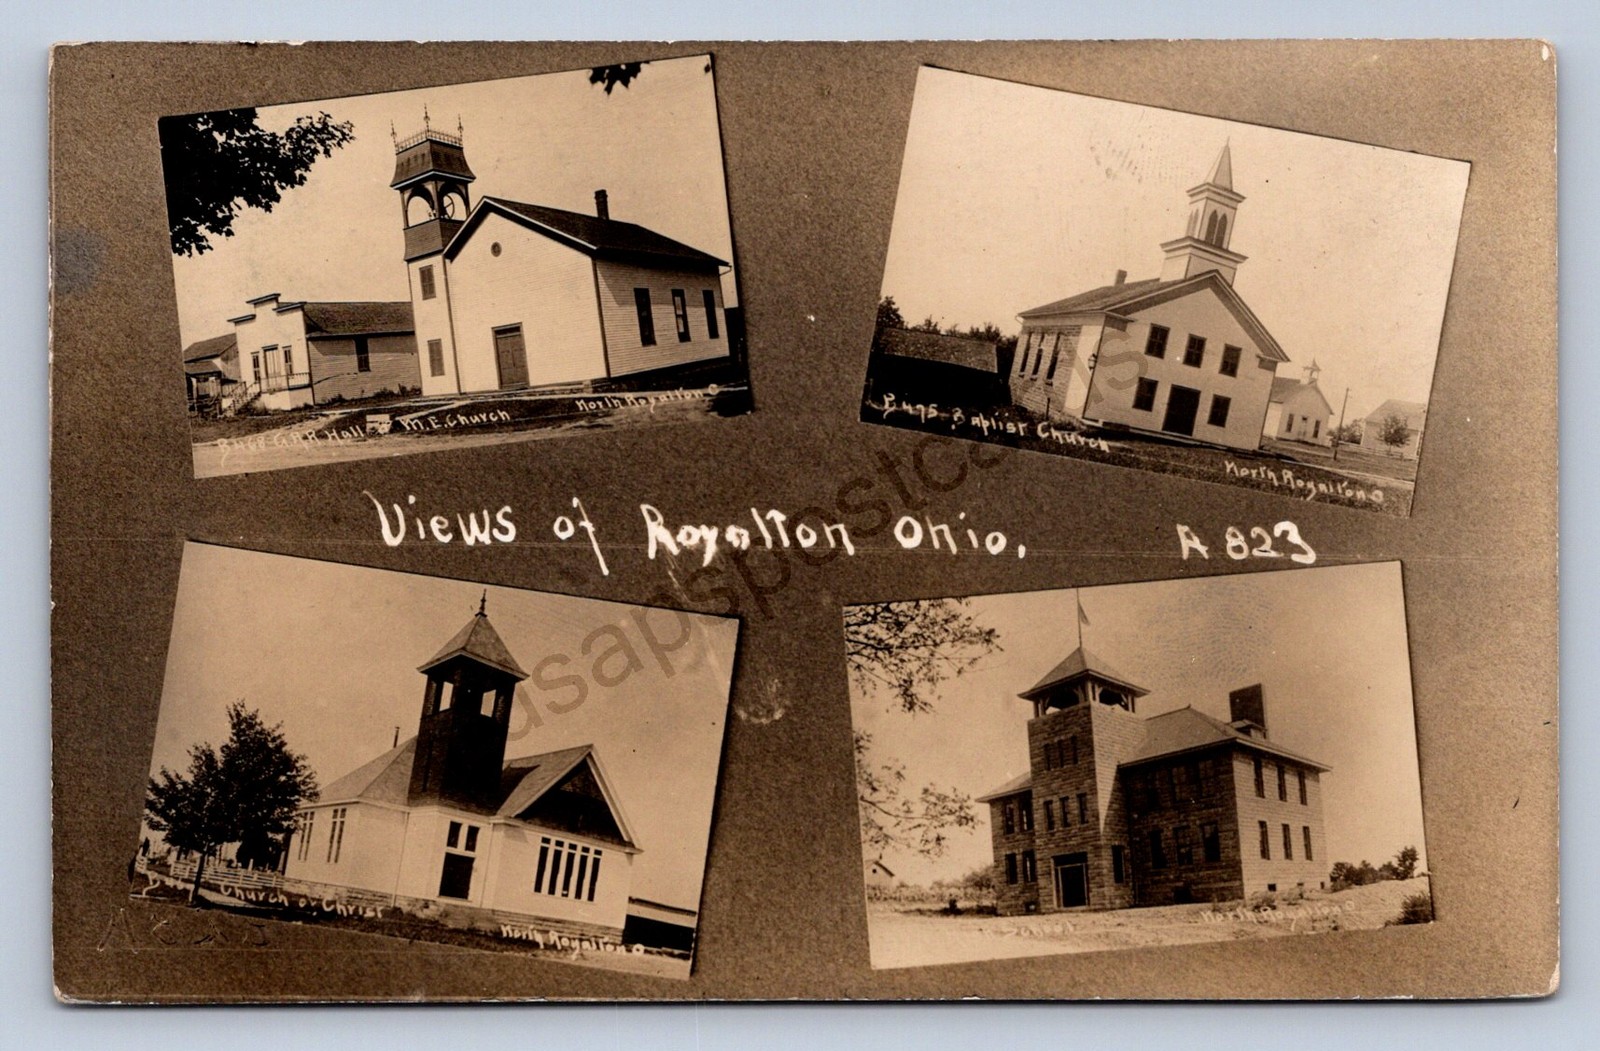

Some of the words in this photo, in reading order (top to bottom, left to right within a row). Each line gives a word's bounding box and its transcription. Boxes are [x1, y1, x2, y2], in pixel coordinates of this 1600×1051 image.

[574, 398, 622, 413] North
[325, 425, 364, 446] Hall
[951, 407, 1027, 437] Baptist
[1036, 421, 1111, 453] Church
[1224, 459, 1279, 487] North
[1281, 468, 1367, 501] Royalton
[362, 489, 517, 547] Views
[552, 496, 610, 576] of
[638, 502, 856, 568] Royalton
[1175, 523, 1210, 561] A
[1224, 520, 1317, 565] 823
[220, 882, 289, 907] Church
[321, 896, 388, 920] Christ
[500, 923, 546, 949] North
